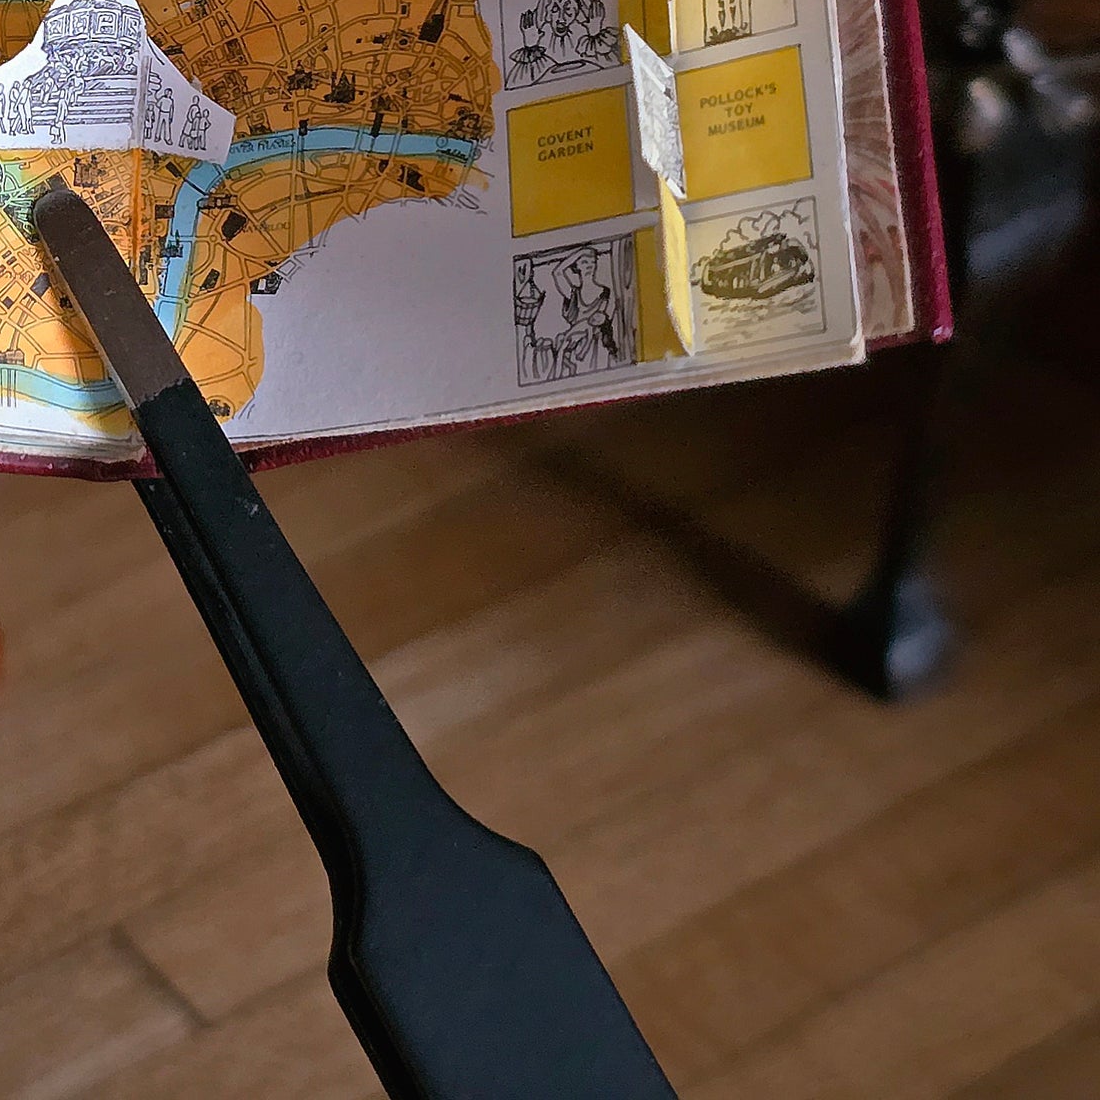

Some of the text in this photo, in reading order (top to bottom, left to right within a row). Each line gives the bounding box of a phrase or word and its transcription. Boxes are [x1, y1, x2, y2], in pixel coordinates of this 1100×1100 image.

[700, 82, 777, 109] POLLOCK'S
[724, 102, 754, 116] TOY
[537, 126, 594, 148] COVENT
[708, 116, 765, 136] MUSEUM
[538, 140, 594, 162] GARDEN
